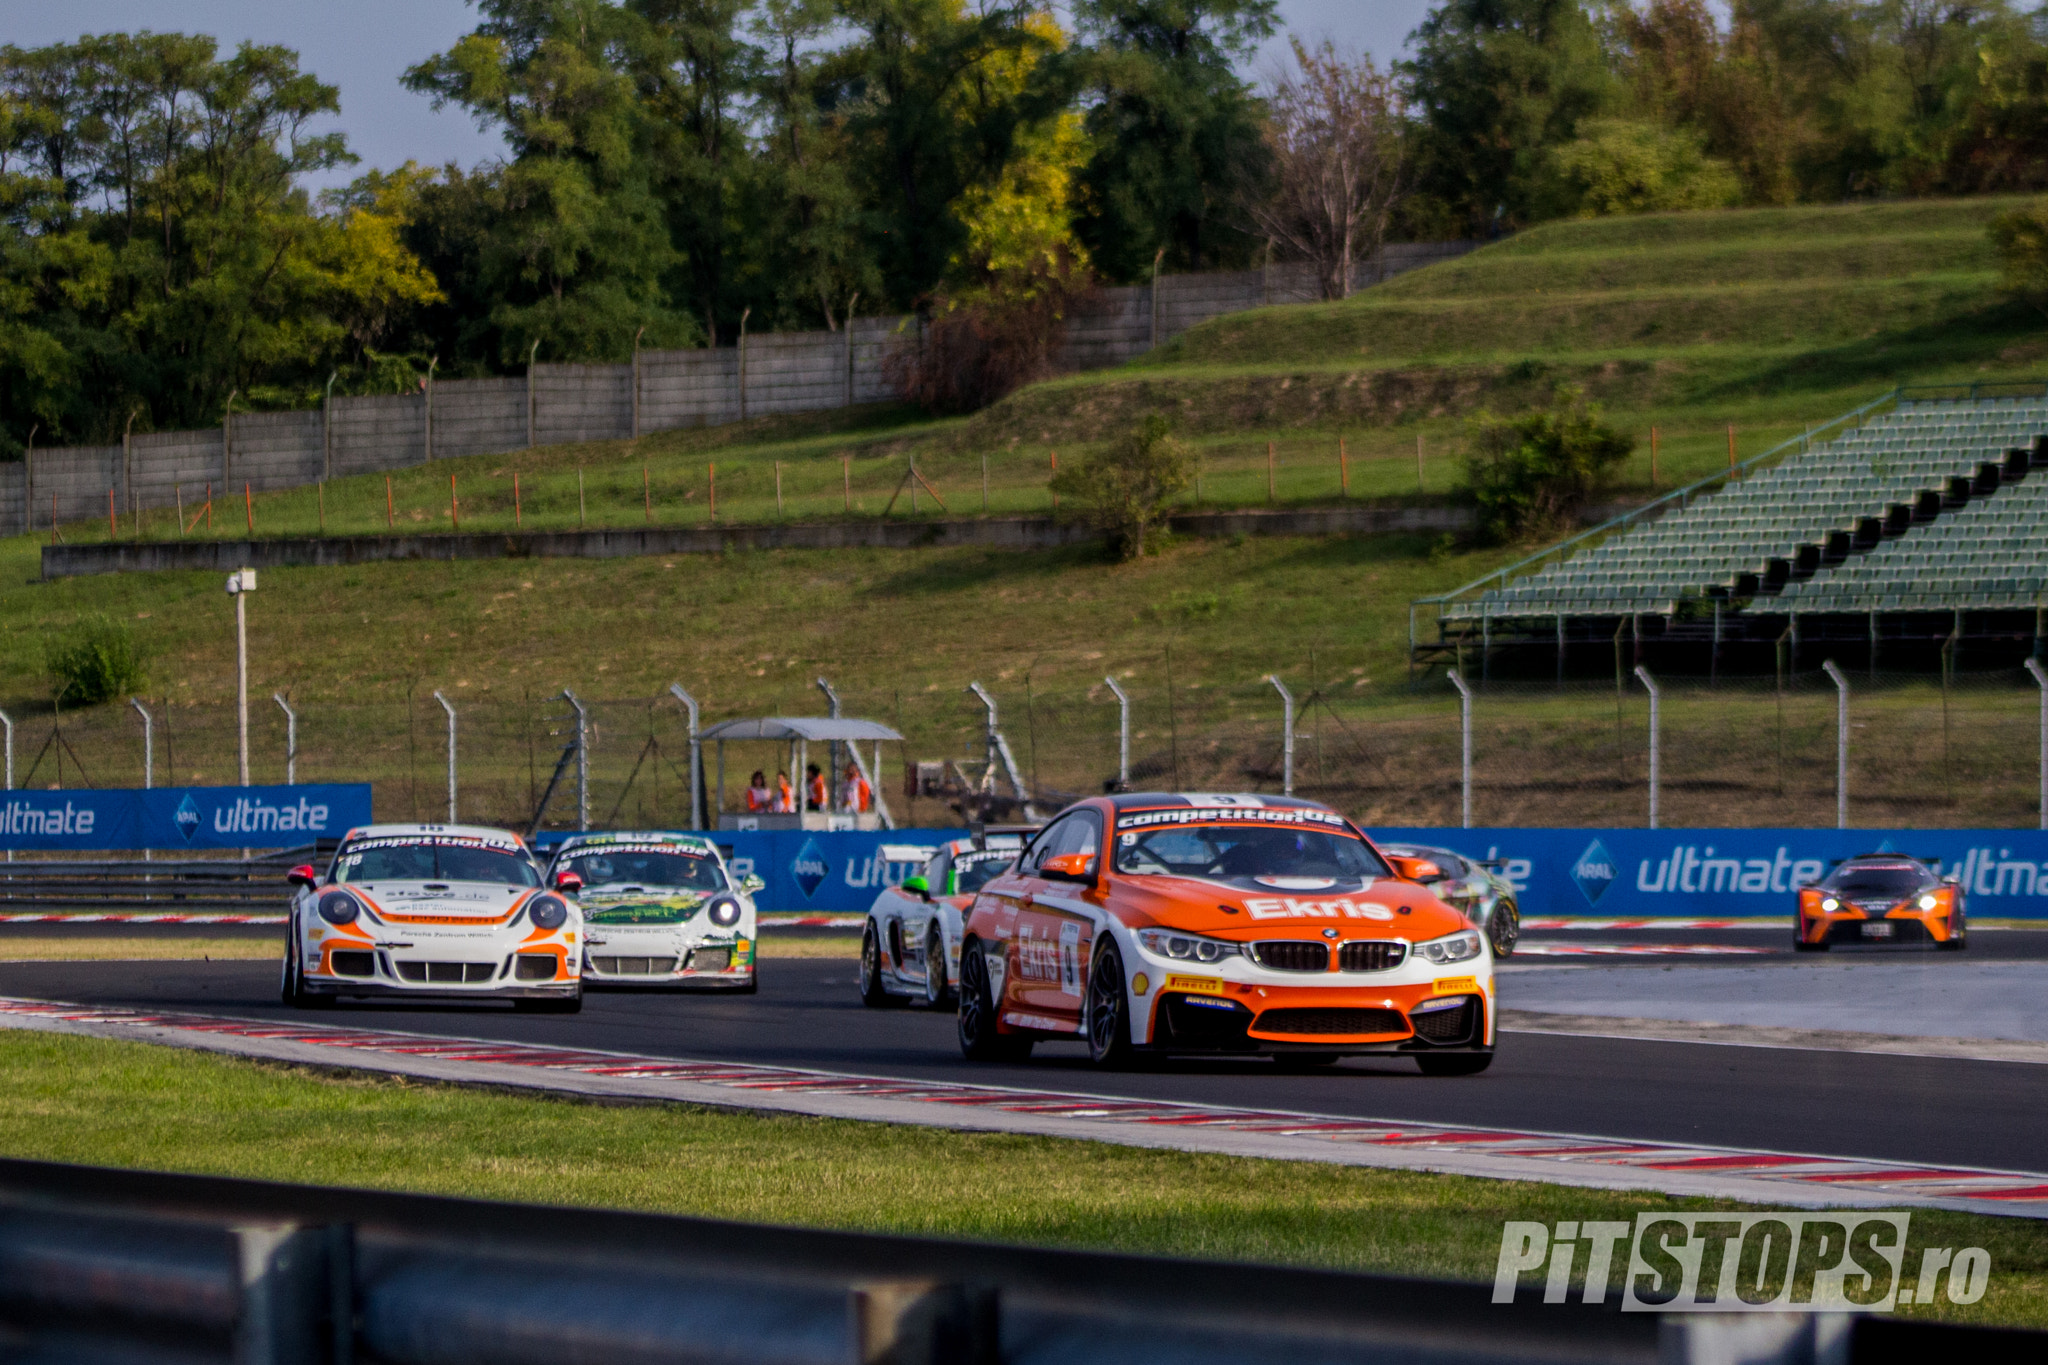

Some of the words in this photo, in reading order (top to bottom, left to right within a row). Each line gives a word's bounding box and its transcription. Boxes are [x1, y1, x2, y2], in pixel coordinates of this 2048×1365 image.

[214, 797, 328, 832] ultimate
[1121, 832, 1137, 846] 9
[345, 855, 363, 867] 18
[1577, 863, 1613, 879] ARAL
[1637, 847, 1823, 893] ultimate
[1242, 898, 1394, 921] Ekris
[1171, 977, 1216, 991] PIRELLI
[1438, 979, 1473, 990] PIRELLI
